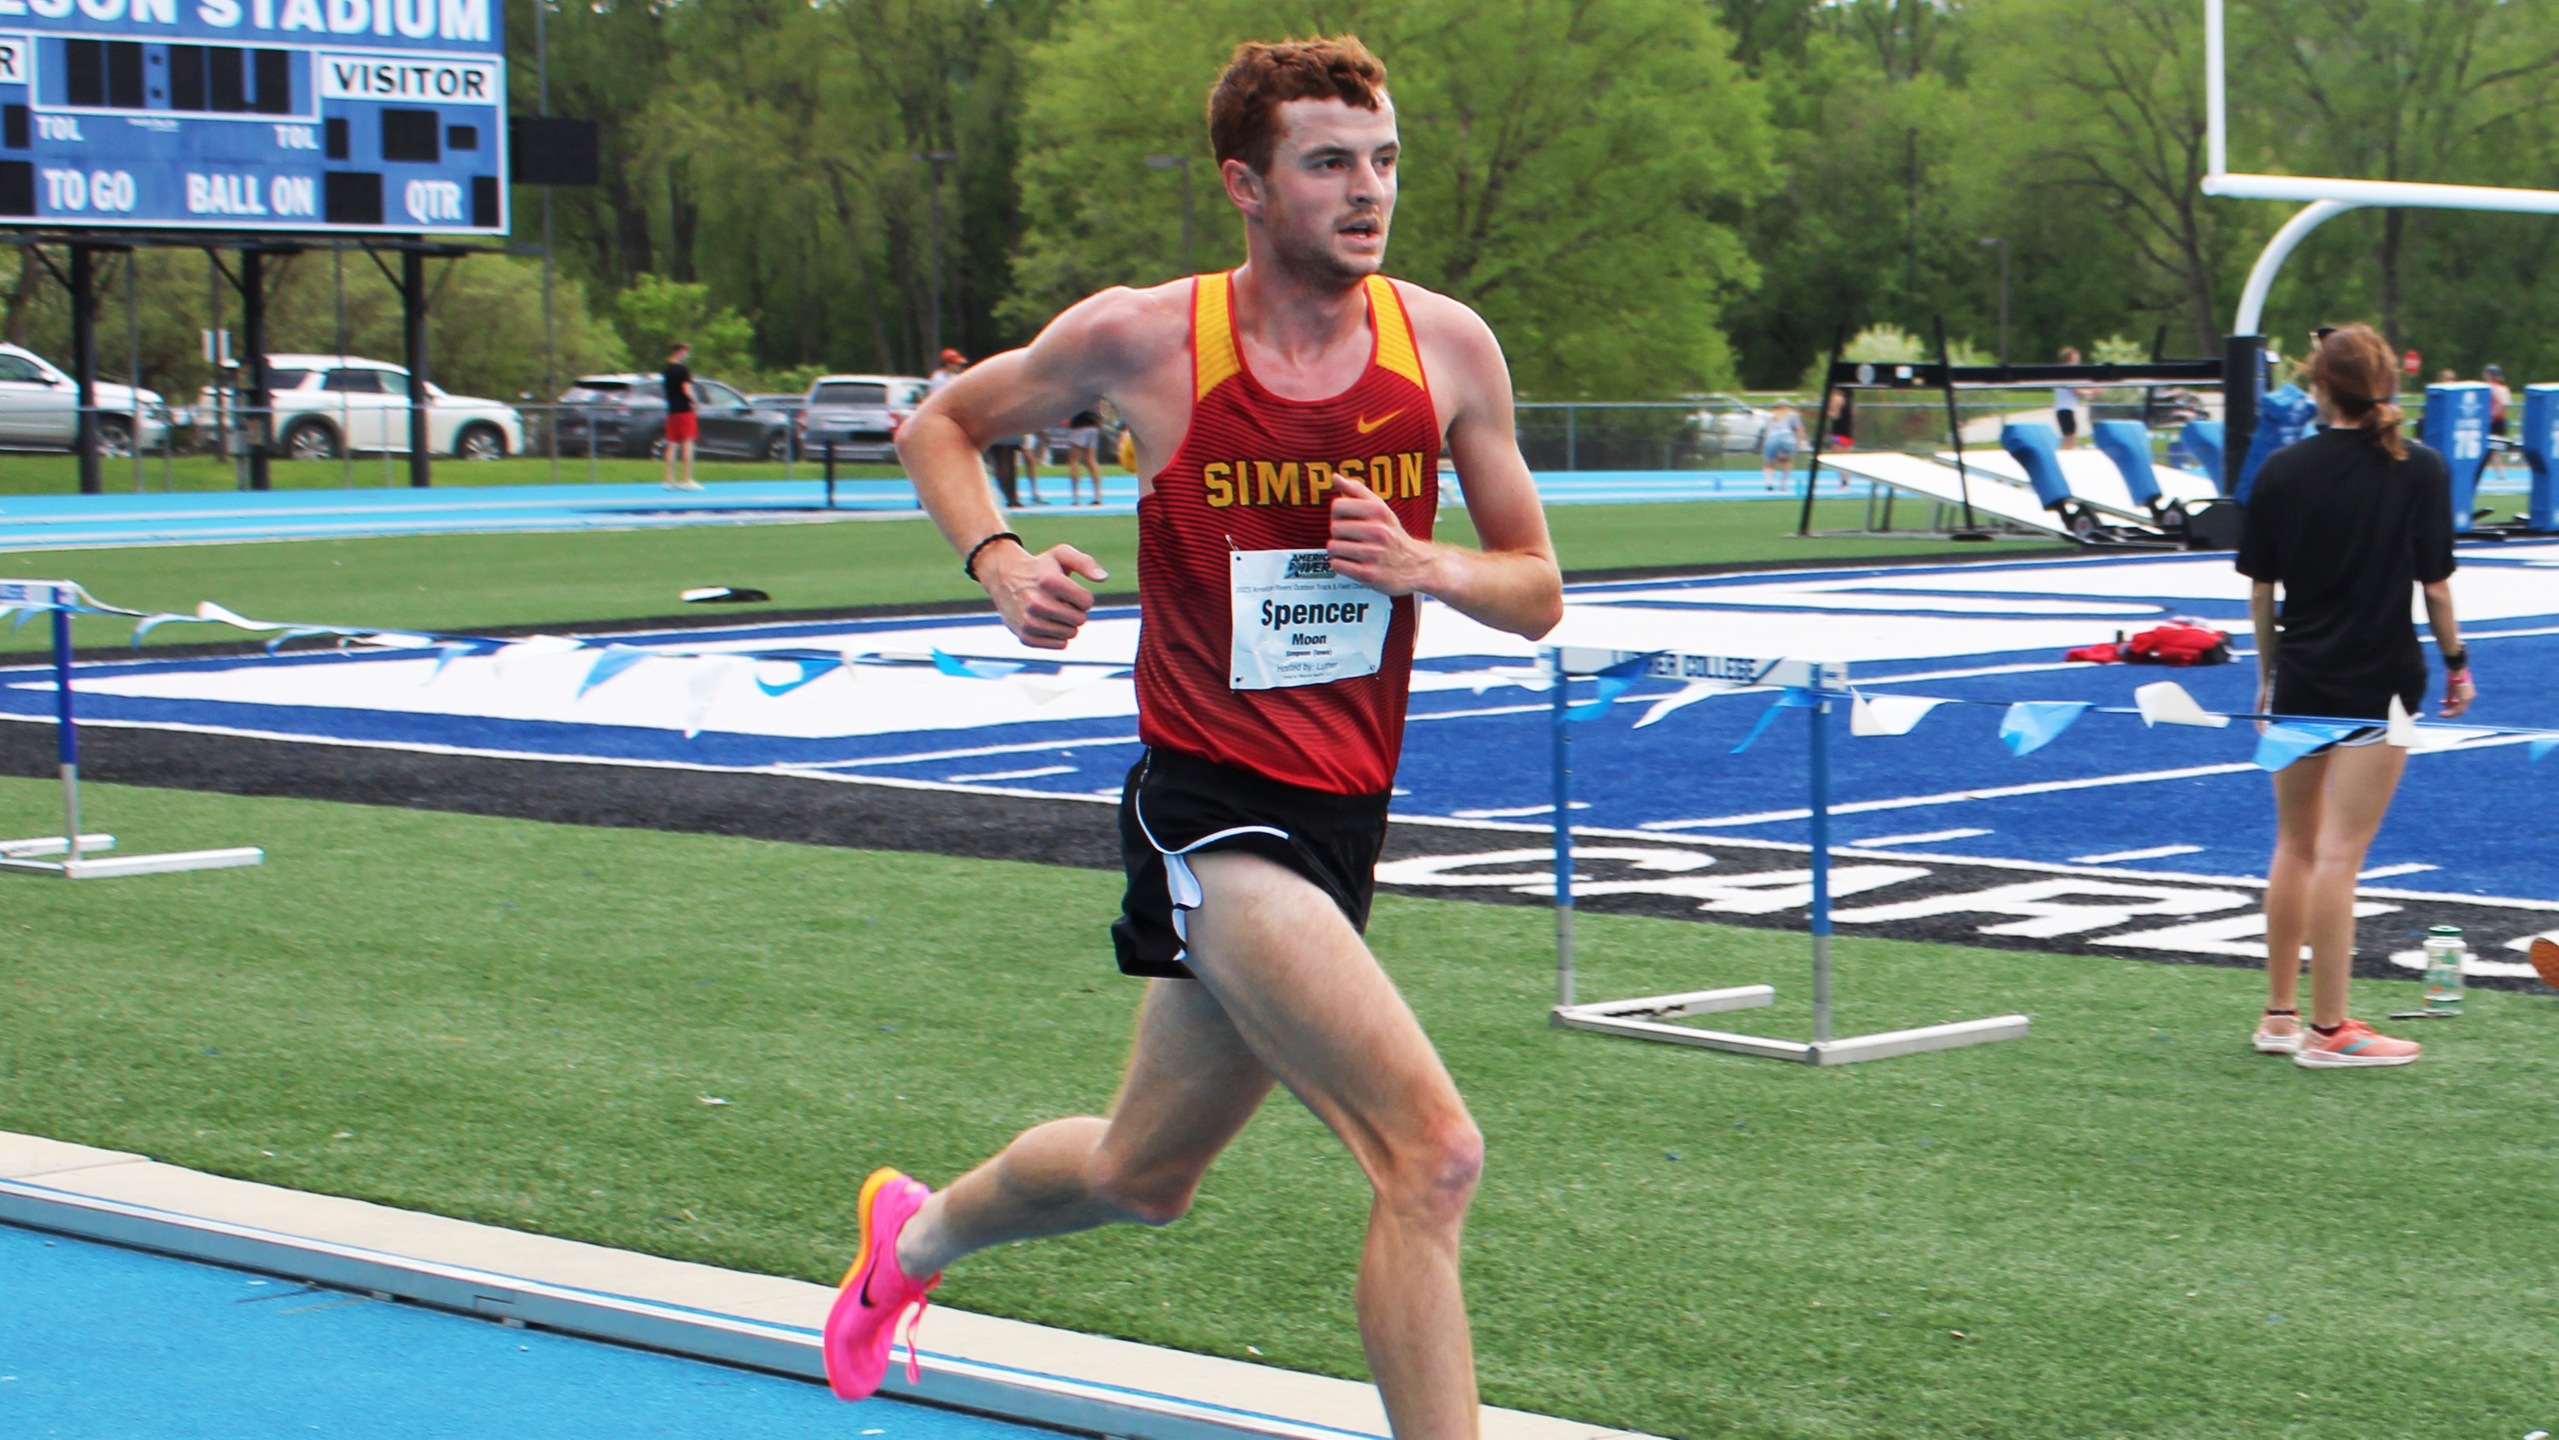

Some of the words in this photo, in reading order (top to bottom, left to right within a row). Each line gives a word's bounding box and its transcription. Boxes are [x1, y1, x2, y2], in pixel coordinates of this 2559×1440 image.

[195, 0, 491, 42] STADIUM
[332, 62, 486, 98] VISITOR
[37, 116, 84, 142] TOL
[274, 125, 319, 150] TOL
[43, 170, 87, 211] TO
[90, 171, 135, 213] GO
[186, 173, 267, 216] BALL
[271, 177, 316, 217] ON
[405, 180, 463, 224] QTR
[1204, 452, 1424, 508] SIMPSON
[1288, 562, 1335, 573] RIVER
[1290, 553, 1332, 562] AMERIC
[1261, 599, 1369, 631] Spencer
[1292, 633, 1327, 645] Moon
[1685, 655, 1757, 680] COLLEGE
